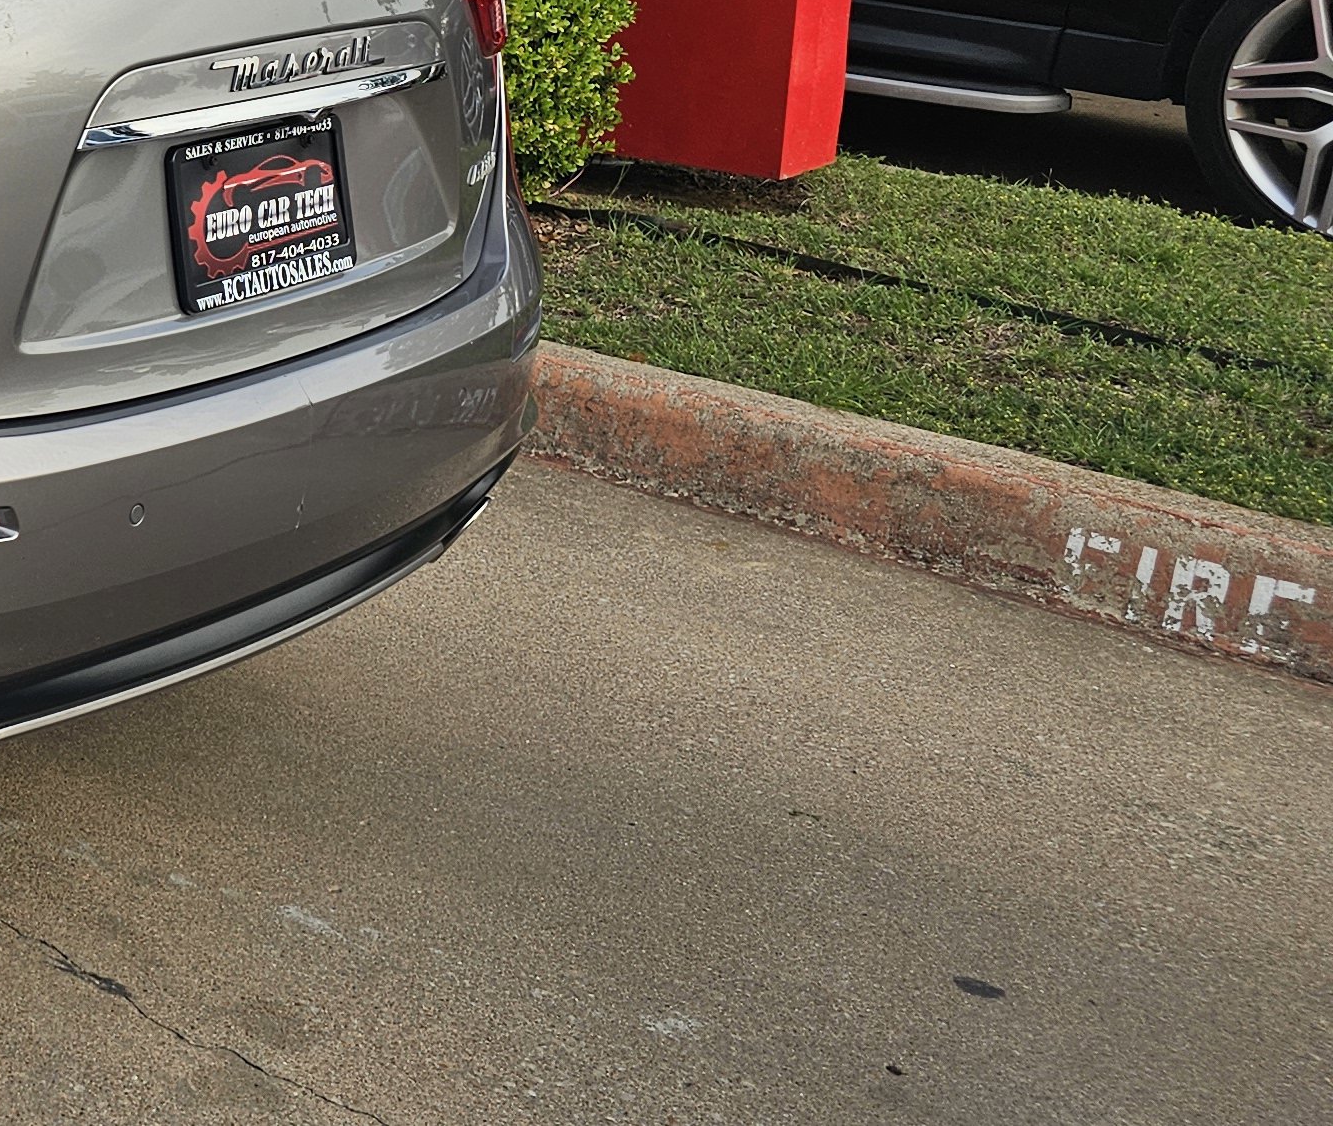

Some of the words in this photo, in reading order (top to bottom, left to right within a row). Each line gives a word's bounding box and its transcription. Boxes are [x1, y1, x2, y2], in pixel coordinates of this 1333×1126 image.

[185, 144, 213, 161] SALES
[214, 140, 223, 154] &
[224, 132, 265, 152] SERVICE
[205, 205, 253, 243] EURO
[257, 195, 291, 229] CAR
[294, 184, 335, 219] TECH
[248, 225, 290, 244] european
[290, 212, 338, 235] automotive
[251, 233, 340, 268] 817-404-4033
[196, 250, 354, 312] www.ECTAUTOSALES.com
